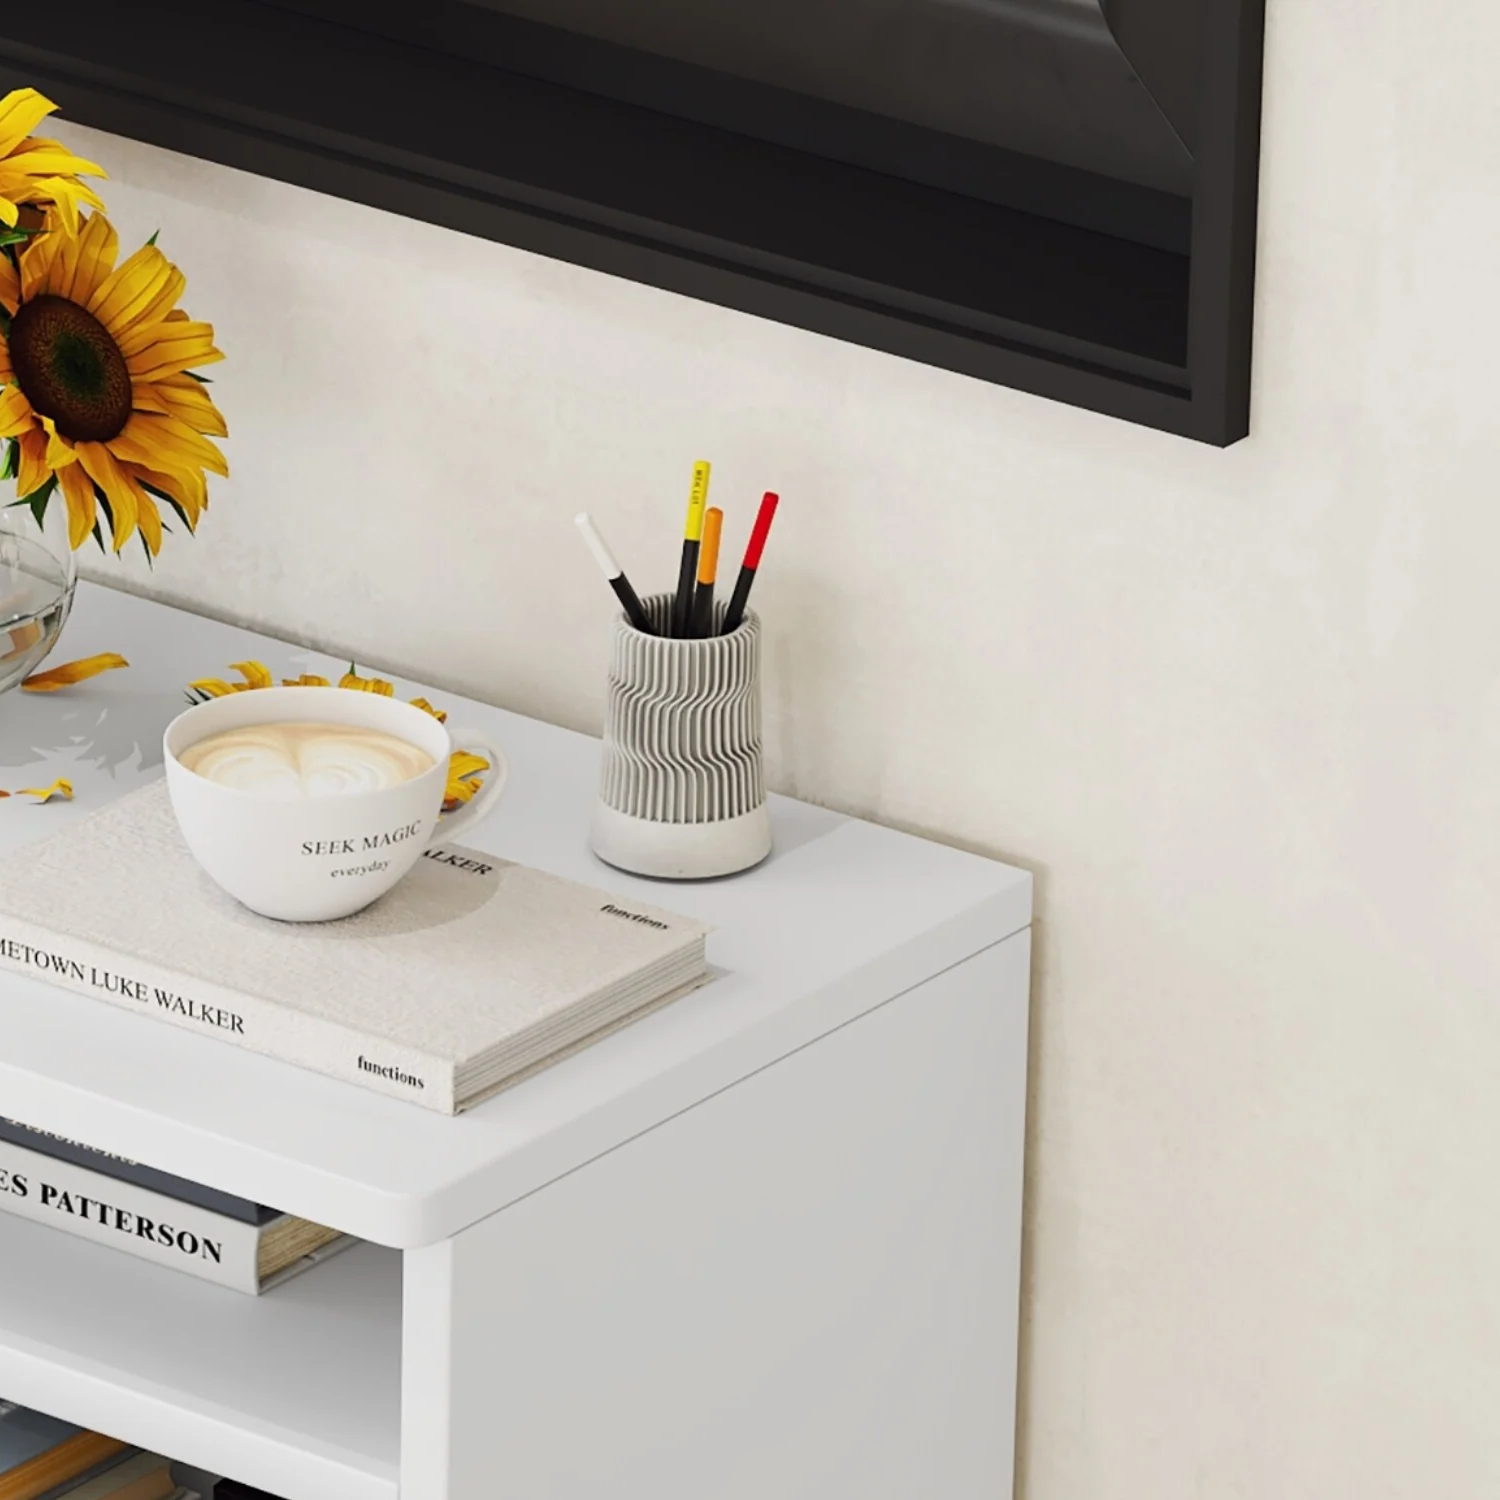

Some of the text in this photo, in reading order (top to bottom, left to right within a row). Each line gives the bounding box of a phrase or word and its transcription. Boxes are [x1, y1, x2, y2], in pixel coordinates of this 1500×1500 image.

[301, 820, 422, 856] SEEK MAGIC
[330, 859, 391, 878] everyday
[600, 904, 670, 930] functions
[91, 968, 149, 1002] LUKE
[154, 988, 245, 1034] WALKER
[357, 1054, 425, 1090] functions
[39, 1183, 222, 1264] PATTERSON
